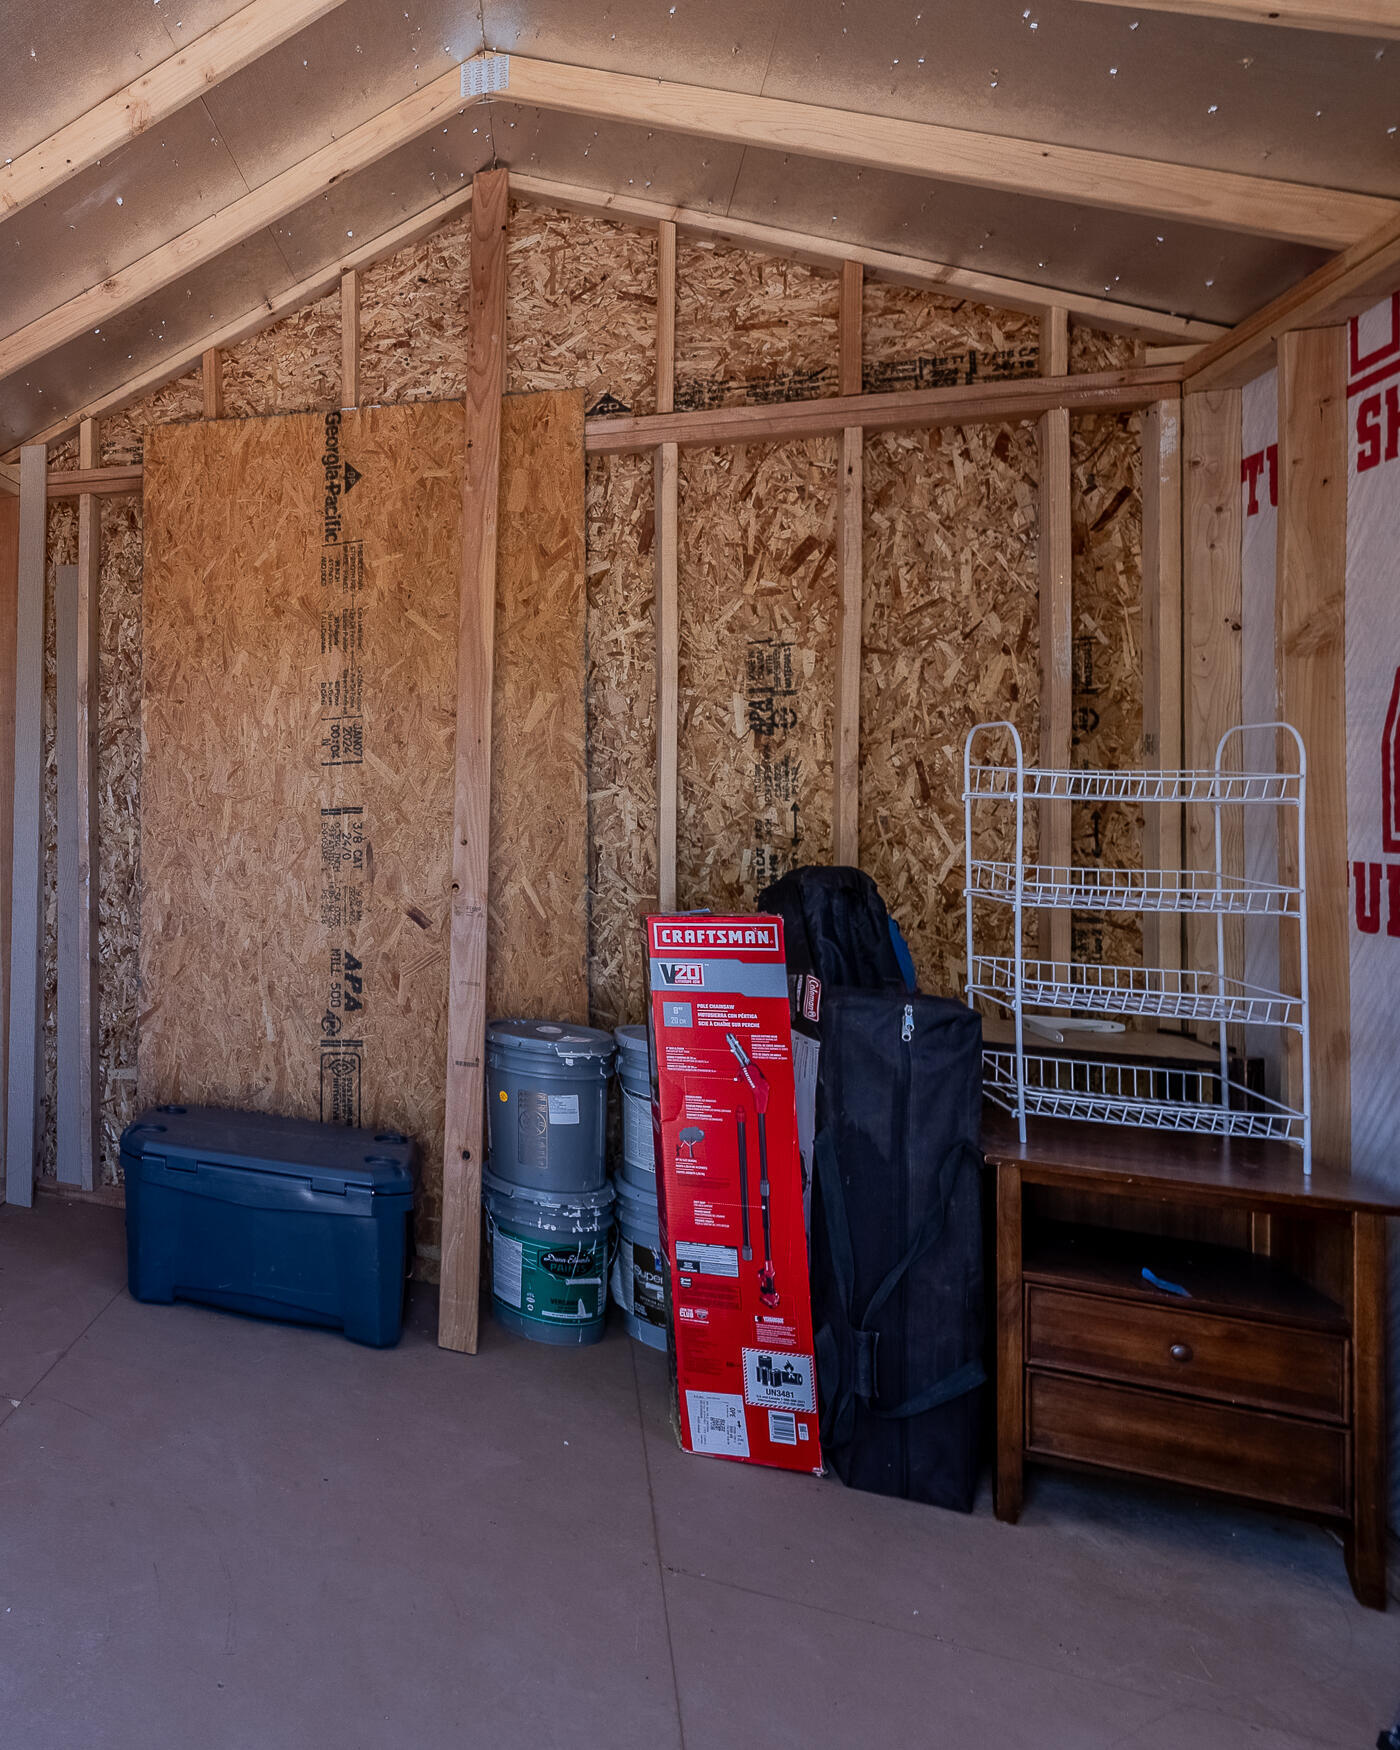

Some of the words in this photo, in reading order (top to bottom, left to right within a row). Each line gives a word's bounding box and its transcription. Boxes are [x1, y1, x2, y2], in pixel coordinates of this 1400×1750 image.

[342, 726, 352, 754] 2024
[352, 822, 363, 844] 3/8
[342, 832, 352, 861] 24/0
[352, 850, 363, 870] CAT
[661, 929, 770, 945] CRAFTSMAN
[330, 948, 341, 975] MILL
[344, 950, 363, 1012] APA
[330, 982, 341, 1008] 500
[807, 979, 819, 1011] Coleman
[765, 1388, 794, 1399] UN3481
